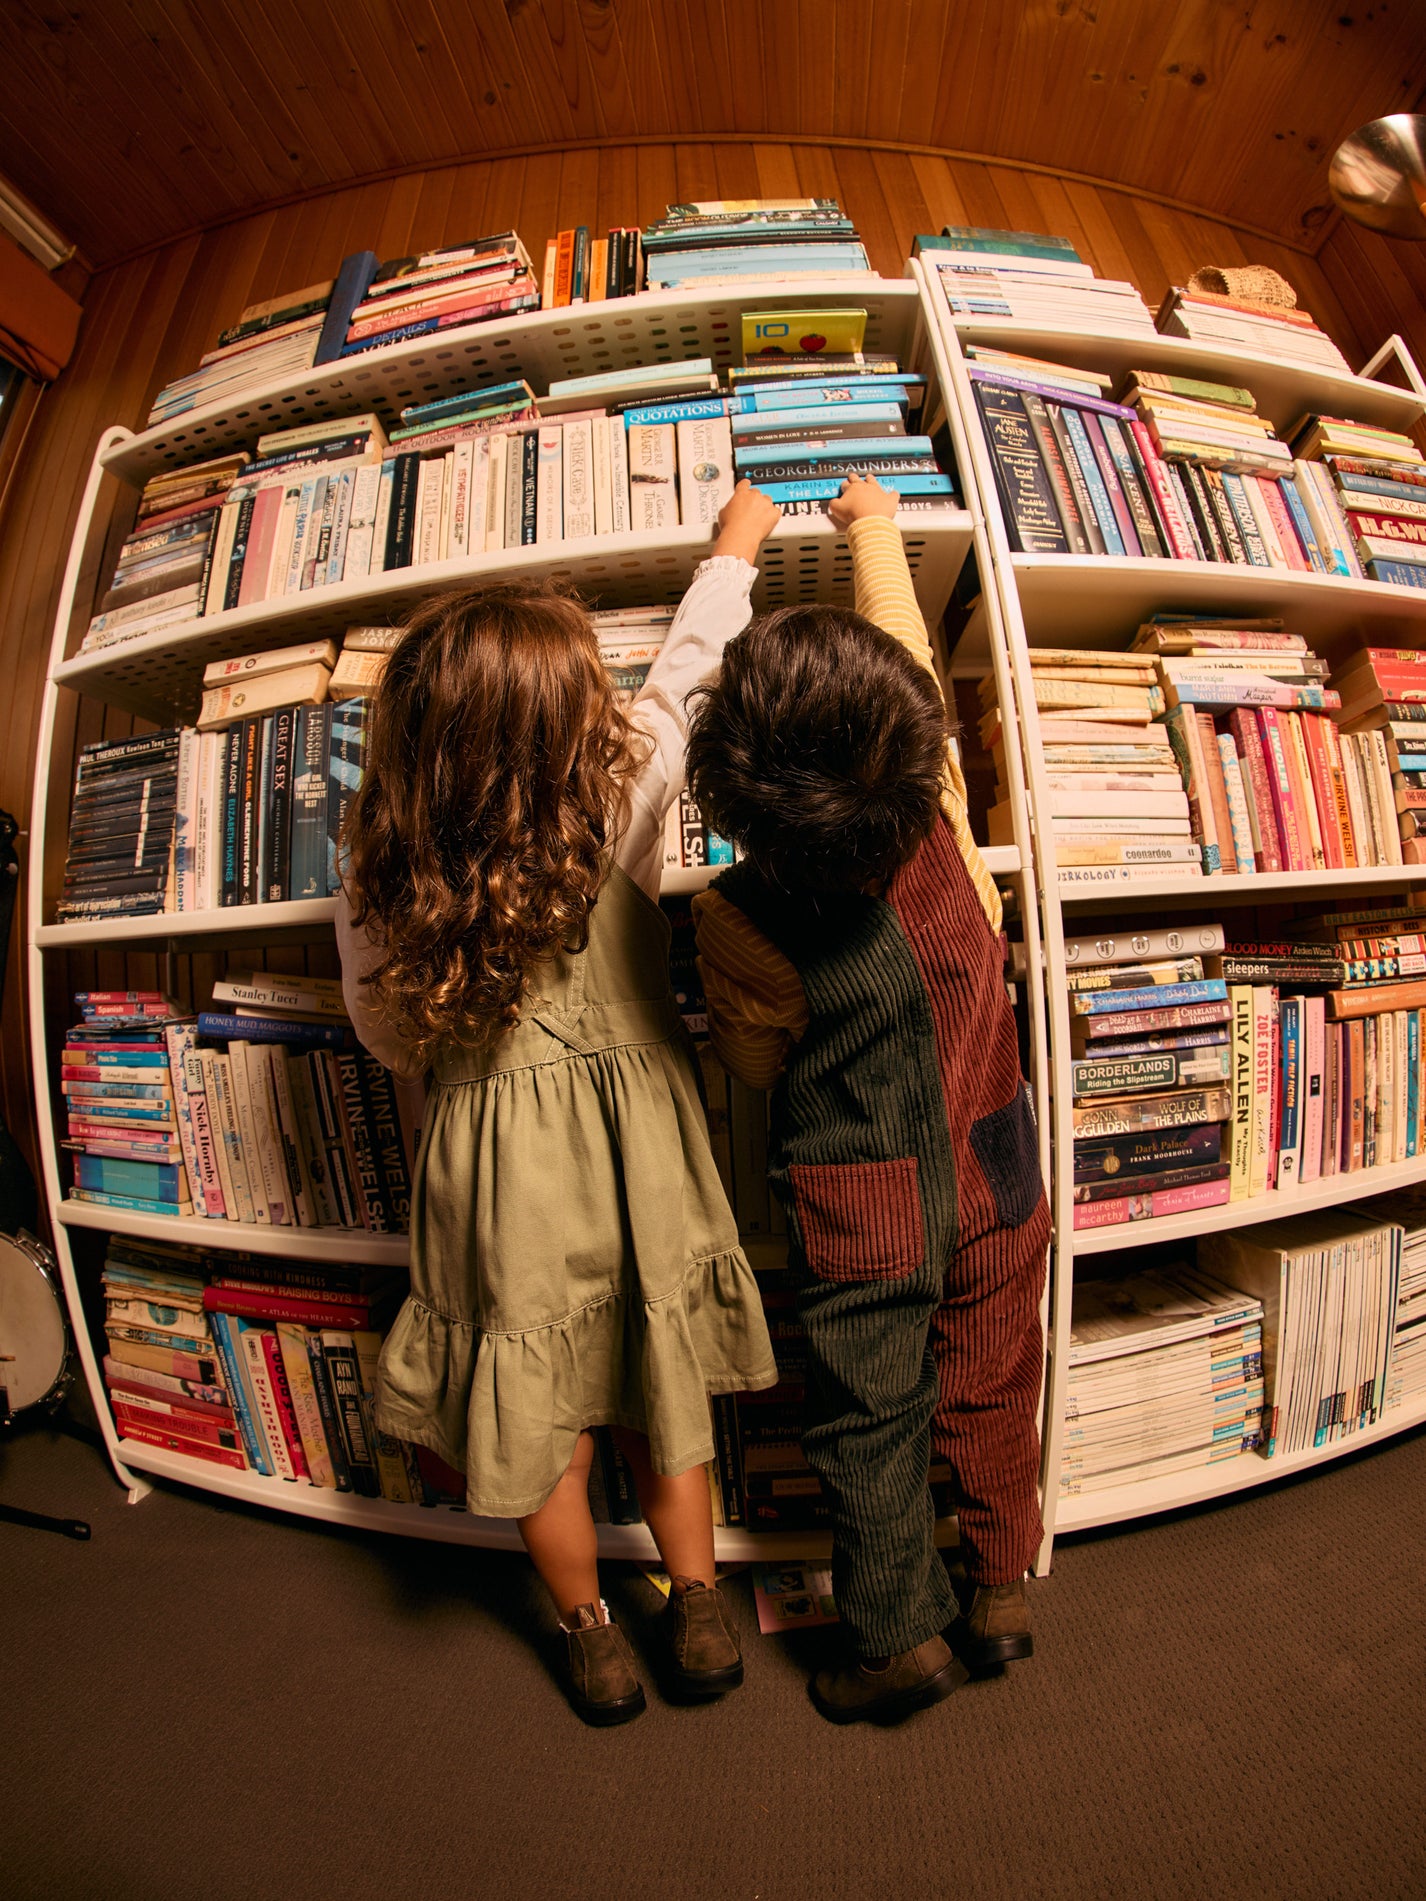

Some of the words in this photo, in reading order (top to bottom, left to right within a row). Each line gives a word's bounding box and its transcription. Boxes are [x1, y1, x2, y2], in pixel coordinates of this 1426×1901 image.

[372, 321, 427, 344] DETAILS
[629, 402, 722, 423] QUOTATIONS
[1000, 419, 1018, 428] JANE
[393, 442, 408, 452] THE
[411, 433, 457, 448] OUTDOOR
[462, 426, 492, 437] ROOM
[498, 421, 528, 431] JAMIE
[693, 424, 705, 462] MARTIN
[995, 426, 1029, 437] AUSTEN
[245, 463, 255, 472] THE
[255, 458, 275, 470] SECRET
[276, 456, 287, 465] LIFE
[288, 454, 296, 462] OF
[296, 448, 319, 458] WHALES
[571, 441, 585, 467] Nick
[641, 428, 653, 466] MARTIN
[571, 469, 585, 494] Cave
[753, 464, 816, 478] GEORGE
[837, 459, 918, 472] SAUNDERS
[1040, 426, 1060, 462] ALMOST
[1054, 463, 1079, 523] CHIMPANZEE
[1098, 446, 1118, 490] sunbathing
[1107, 426, 1134, 479] HANNAH
[1128, 480, 1146, 516] KENT
[525, 477, 536, 517] VIETNAM
[785, 482, 822, 490] KARIN
[1092, 484, 1110, 532] HOROWITZ
[1098, 483, 1117, 535] ALEXANDRA
[1231, 479, 1260, 534] PATTERSON
[1163, 497, 1189, 558] WETLANDS
[1200, 693, 1238, 702] AUTUMN
[231, 733, 240, 763] NEVER
[248, 724, 256, 751] FIGHT
[279, 714, 290, 759] GREAT
[305, 711, 323, 766] LARSSON
[80, 753, 94, 764] PAUL
[95, 746, 126, 762] THEROUX
[151, 739, 165, 750] Tong
[1275, 737, 1290, 792] WOLFE
[1376, 736, 1386, 767] JAWS
[229, 764, 238, 794] ALONE
[274, 763, 285, 791] SEX
[304, 799, 317, 807] NEST
[1320, 769, 1330, 797] EASTON
[1325, 798, 1336, 822] ELLIS
[228, 798, 236, 844] ELIZABETH
[243, 802, 252, 861] CLEMENTINE
[1335, 784, 1348, 817] IRVINE
[1342, 820, 1353, 858] WELSH
[178, 835, 187, 865] MARK
[225, 845, 233, 882] HAYNES
[1126, 849, 1172, 859] coonardoo
[242, 862, 250, 888] FORD
[177, 866, 186, 912] HADDON
[1326, 914, 1348, 926] BRET
[1353, 910, 1388, 922] EASTON
[1223, 943, 1258, 955] BLOOD
[1259, 944, 1292, 955] MONEY
[1293, 945, 1312, 955] Arden
[1226, 963, 1270, 975] sleepers
[231, 986, 268, 1002] Stanley
[270, 991, 299, 1005] Tucci
[1079, 976, 1111, 990] MOVIES
[89, 993, 111, 1001] Italian
[97, 1005, 124, 1015] Spanish
[1180, 1006, 1222, 1017] CHARLAINE
[1189, 1013, 1217, 1024] HARRIS
[1236, 1000, 1249, 1045] LILY
[169, 1028, 177, 1058] MARK
[1185, 1035, 1212, 1046] HARRIS
[1287, 1039, 1296, 1060] TAMIL
[193, 1057, 202, 1085] Funny
[1078, 1060, 1170, 1080] BORDERLANDS
[1087, 1078, 1110, 1089] Riding
[1111, 1077, 1125, 1086] the
[1126, 1073, 1165, 1086] Slipstream
[1256, 1047, 1269, 1094] FOSTER
[172, 1060, 184, 1108] HADDON
[208, 1082, 217, 1109] RODDY
[1237, 1053, 1250, 1124] ALLEN
[1287, 1080, 1295, 1108] FICTION
[194, 1102, 207, 1131] Nick
[1082, 1111, 1118, 1124] CONN
[1154, 1115, 1173, 1127] THE
[1174, 1109, 1208, 1124] PLAINS
[1159, 1103, 1187, 1115] WOLF
[1189, 1099, 1201, 1111] OF
[212, 1110, 221, 1135] DOYLE
[227, 1104, 235, 1128] FEELING
[232, 1142, 241, 1162] SNOW
[181, 1128, 190, 1150] RED
[339, 1053, 369, 1141] IRVINE
[355, 1147, 389, 1233] WELSH
[1135, 1142, 1158, 1153] Dark
[1160, 1139, 1189, 1151] Palace
[199, 1133, 216, 1186] Hornby
[1130, 1154, 1151, 1163] FRANK
[1154, 1149, 1193, 1160] MOORHOUSE
[185, 1153, 199, 1190] HOUSE
[380, 1146, 410, 1234] WELSH
[1080, 1200, 1123, 1213] maureen
[285, 1272, 326, 1287] KINDNESS
[278, 1286, 320, 1301] RAISING
[322, 1292, 352, 1303] BOYS
[298, 1369, 309, 1390] The
[336, 1360, 353, 1378] AYN
[336, 1381, 357, 1400] RAND
[302, 1393, 314, 1416] Rice
[295, 1401, 310, 1444] MANICKA
[308, 1418, 323, 1453] Mother
[346, 1412, 369, 1462] FOUNTAINHEAD
